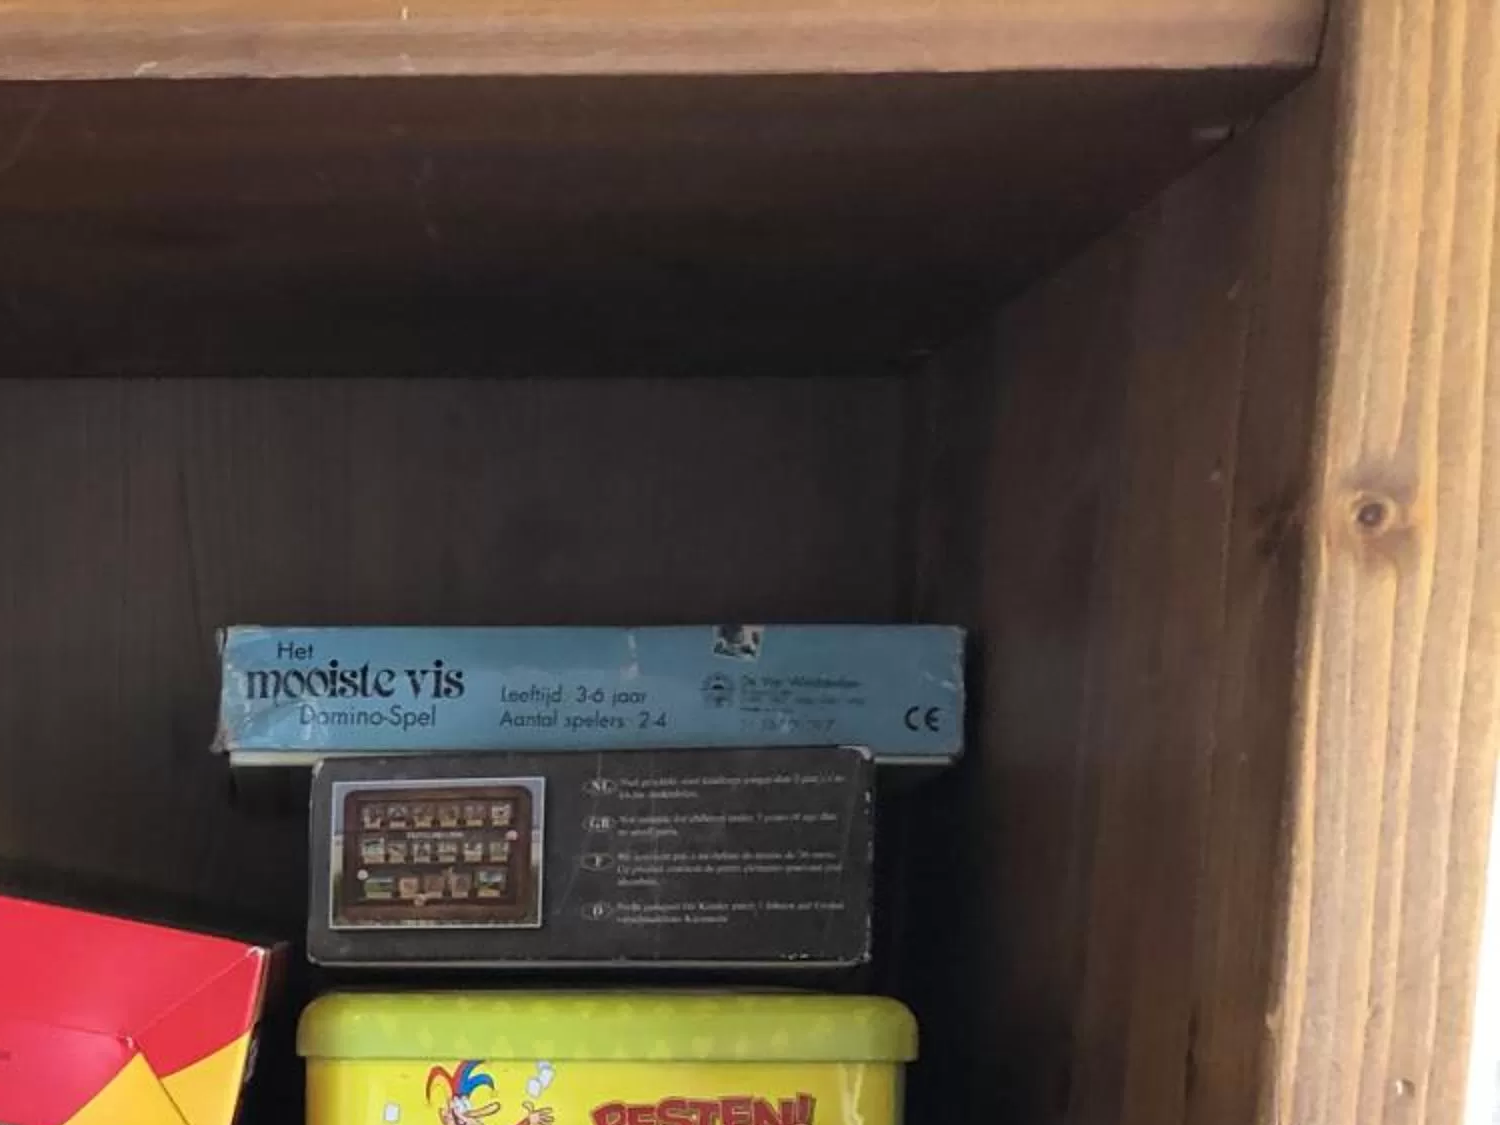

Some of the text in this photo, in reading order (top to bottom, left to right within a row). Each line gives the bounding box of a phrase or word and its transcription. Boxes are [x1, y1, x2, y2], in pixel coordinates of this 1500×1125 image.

[277, 641, 313, 660] Het
[247, 659, 465, 704] mooiste vis
[576, 685, 605, 703] 3-6
[612, 686, 647, 706] jaar
[300, 704, 436, 731] Domino-Spel
[499, 710, 558, 728] Aantal
